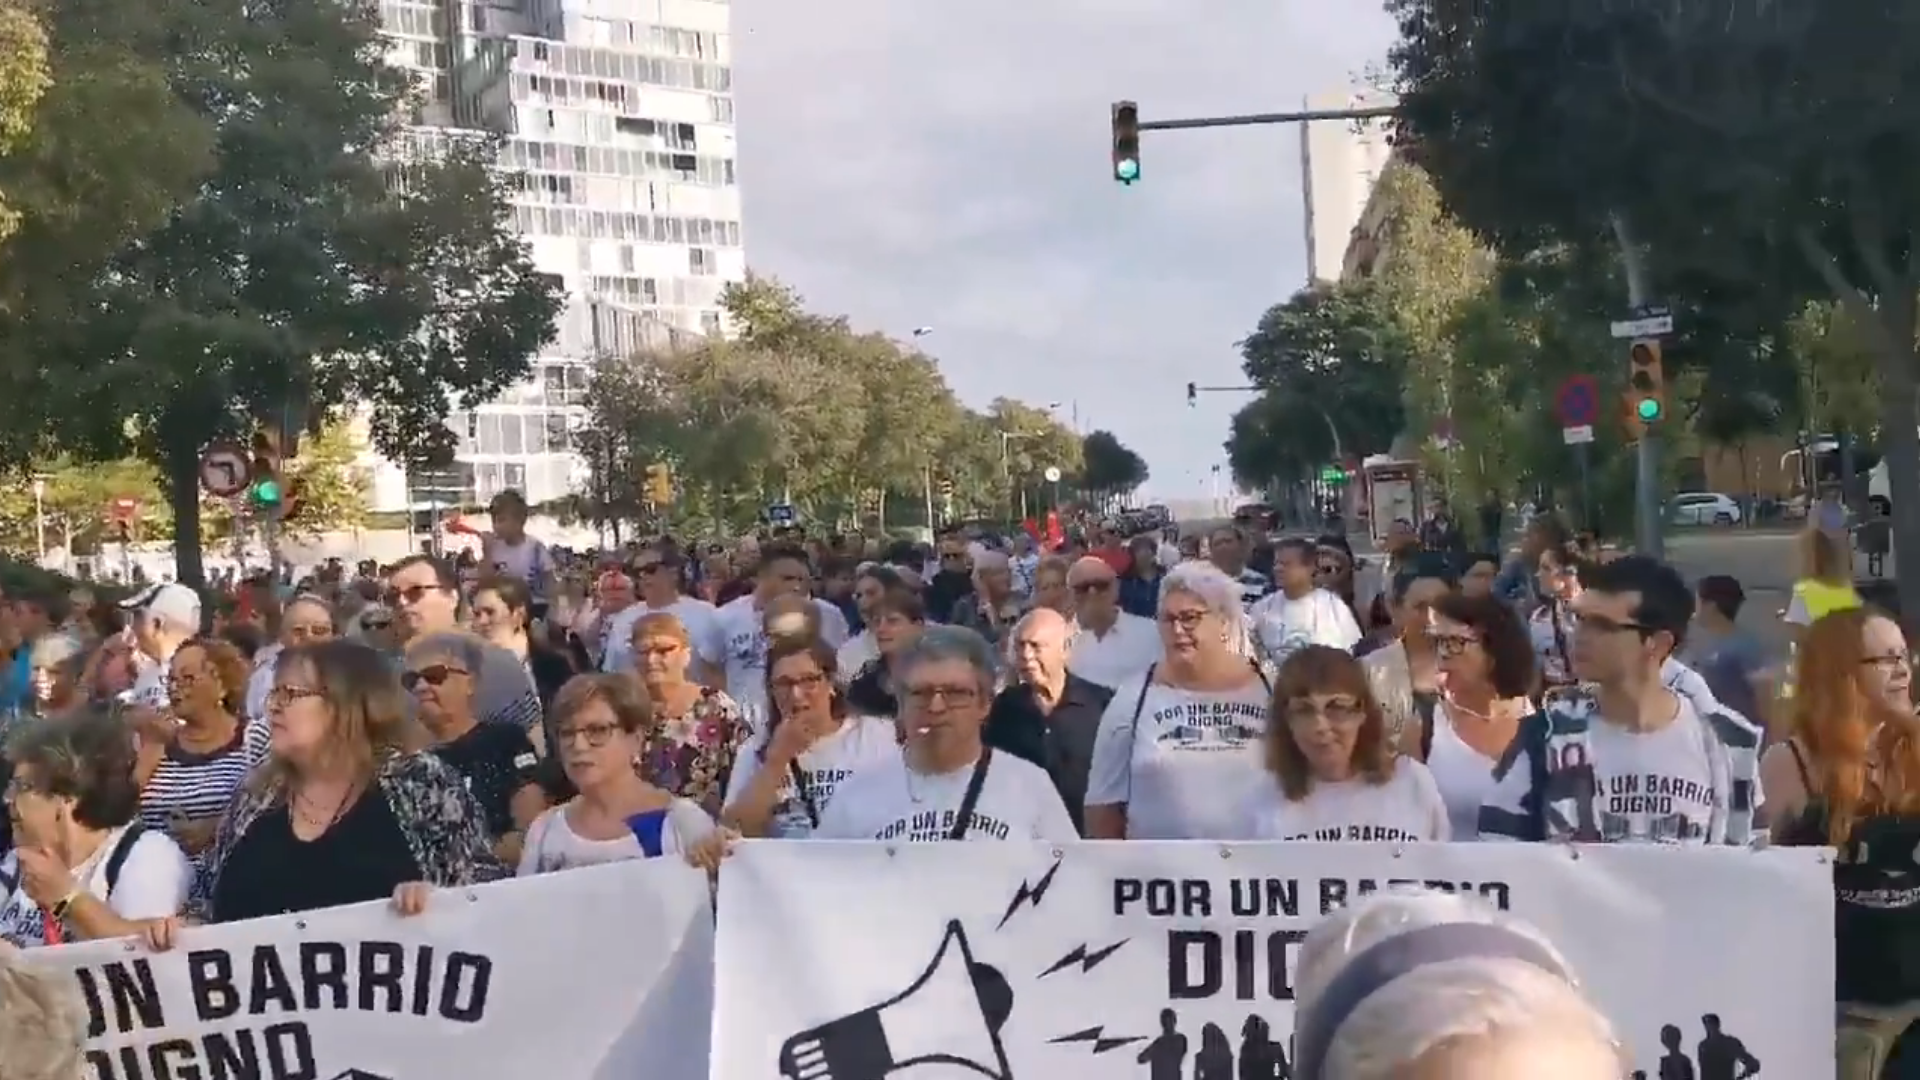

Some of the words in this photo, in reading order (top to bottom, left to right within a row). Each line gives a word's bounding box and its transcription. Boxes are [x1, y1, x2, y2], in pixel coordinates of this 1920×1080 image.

[1610, 796, 1671, 814] DIGNO
[1611, 775, 1638, 794] UN
[1645, 775, 1715, 806] BARRIO
[1114, 878, 1211, 917] POR
[1230, 878, 1299, 916] UN
[188, 941, 493, 1023] BARRIO
